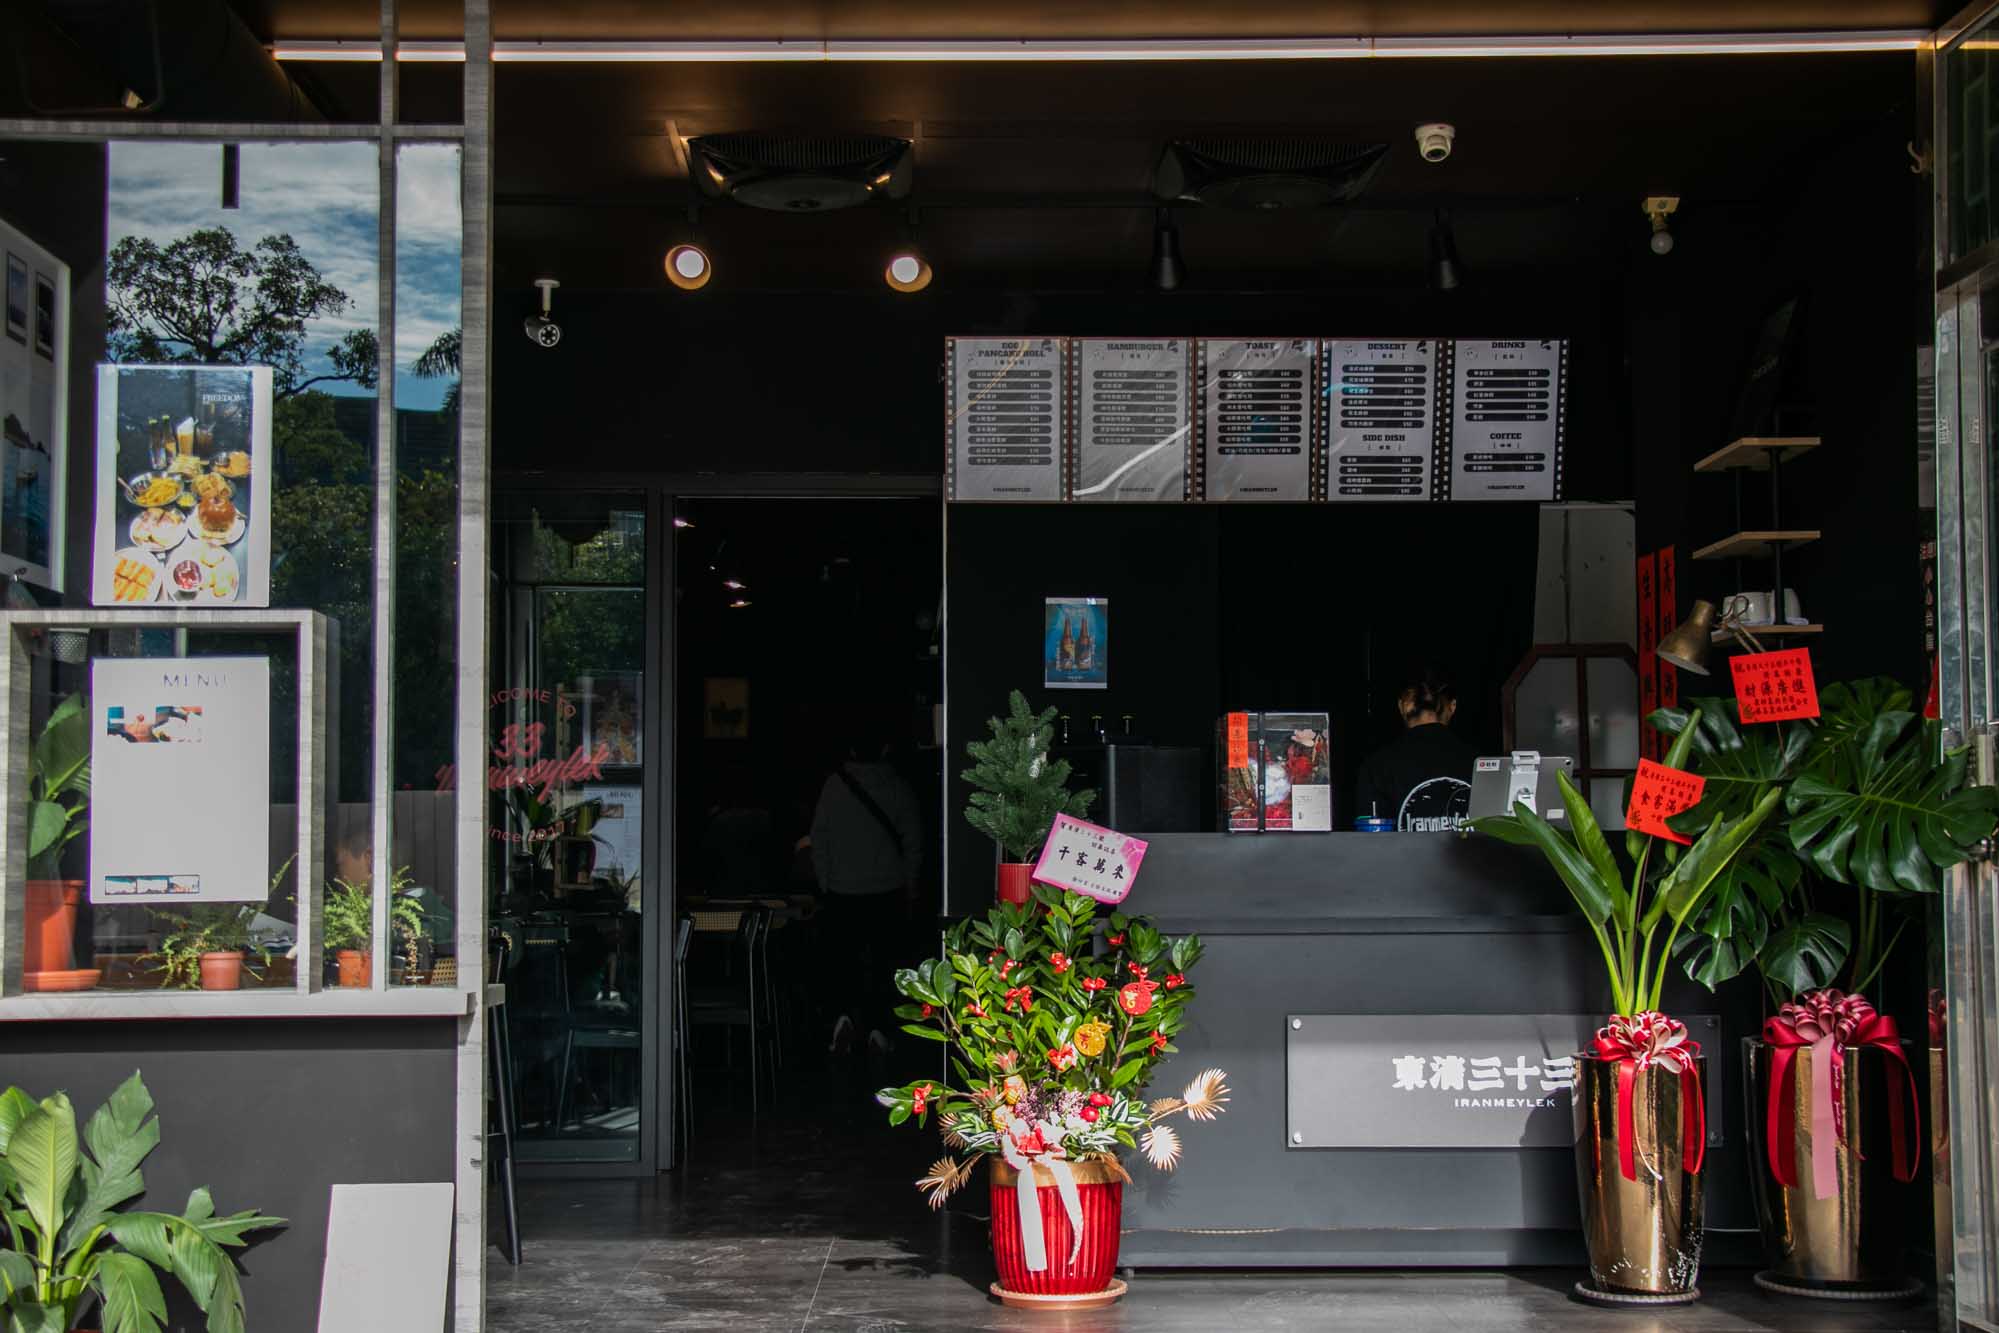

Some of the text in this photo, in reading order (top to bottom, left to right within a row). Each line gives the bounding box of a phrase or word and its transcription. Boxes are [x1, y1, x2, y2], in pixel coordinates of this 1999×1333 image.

[495, 721, 545, 759] 33
[1058, 846, 1124, 880] 千客萬來
[1455, 1098, 1555, 1108] IRANMEYLEK
